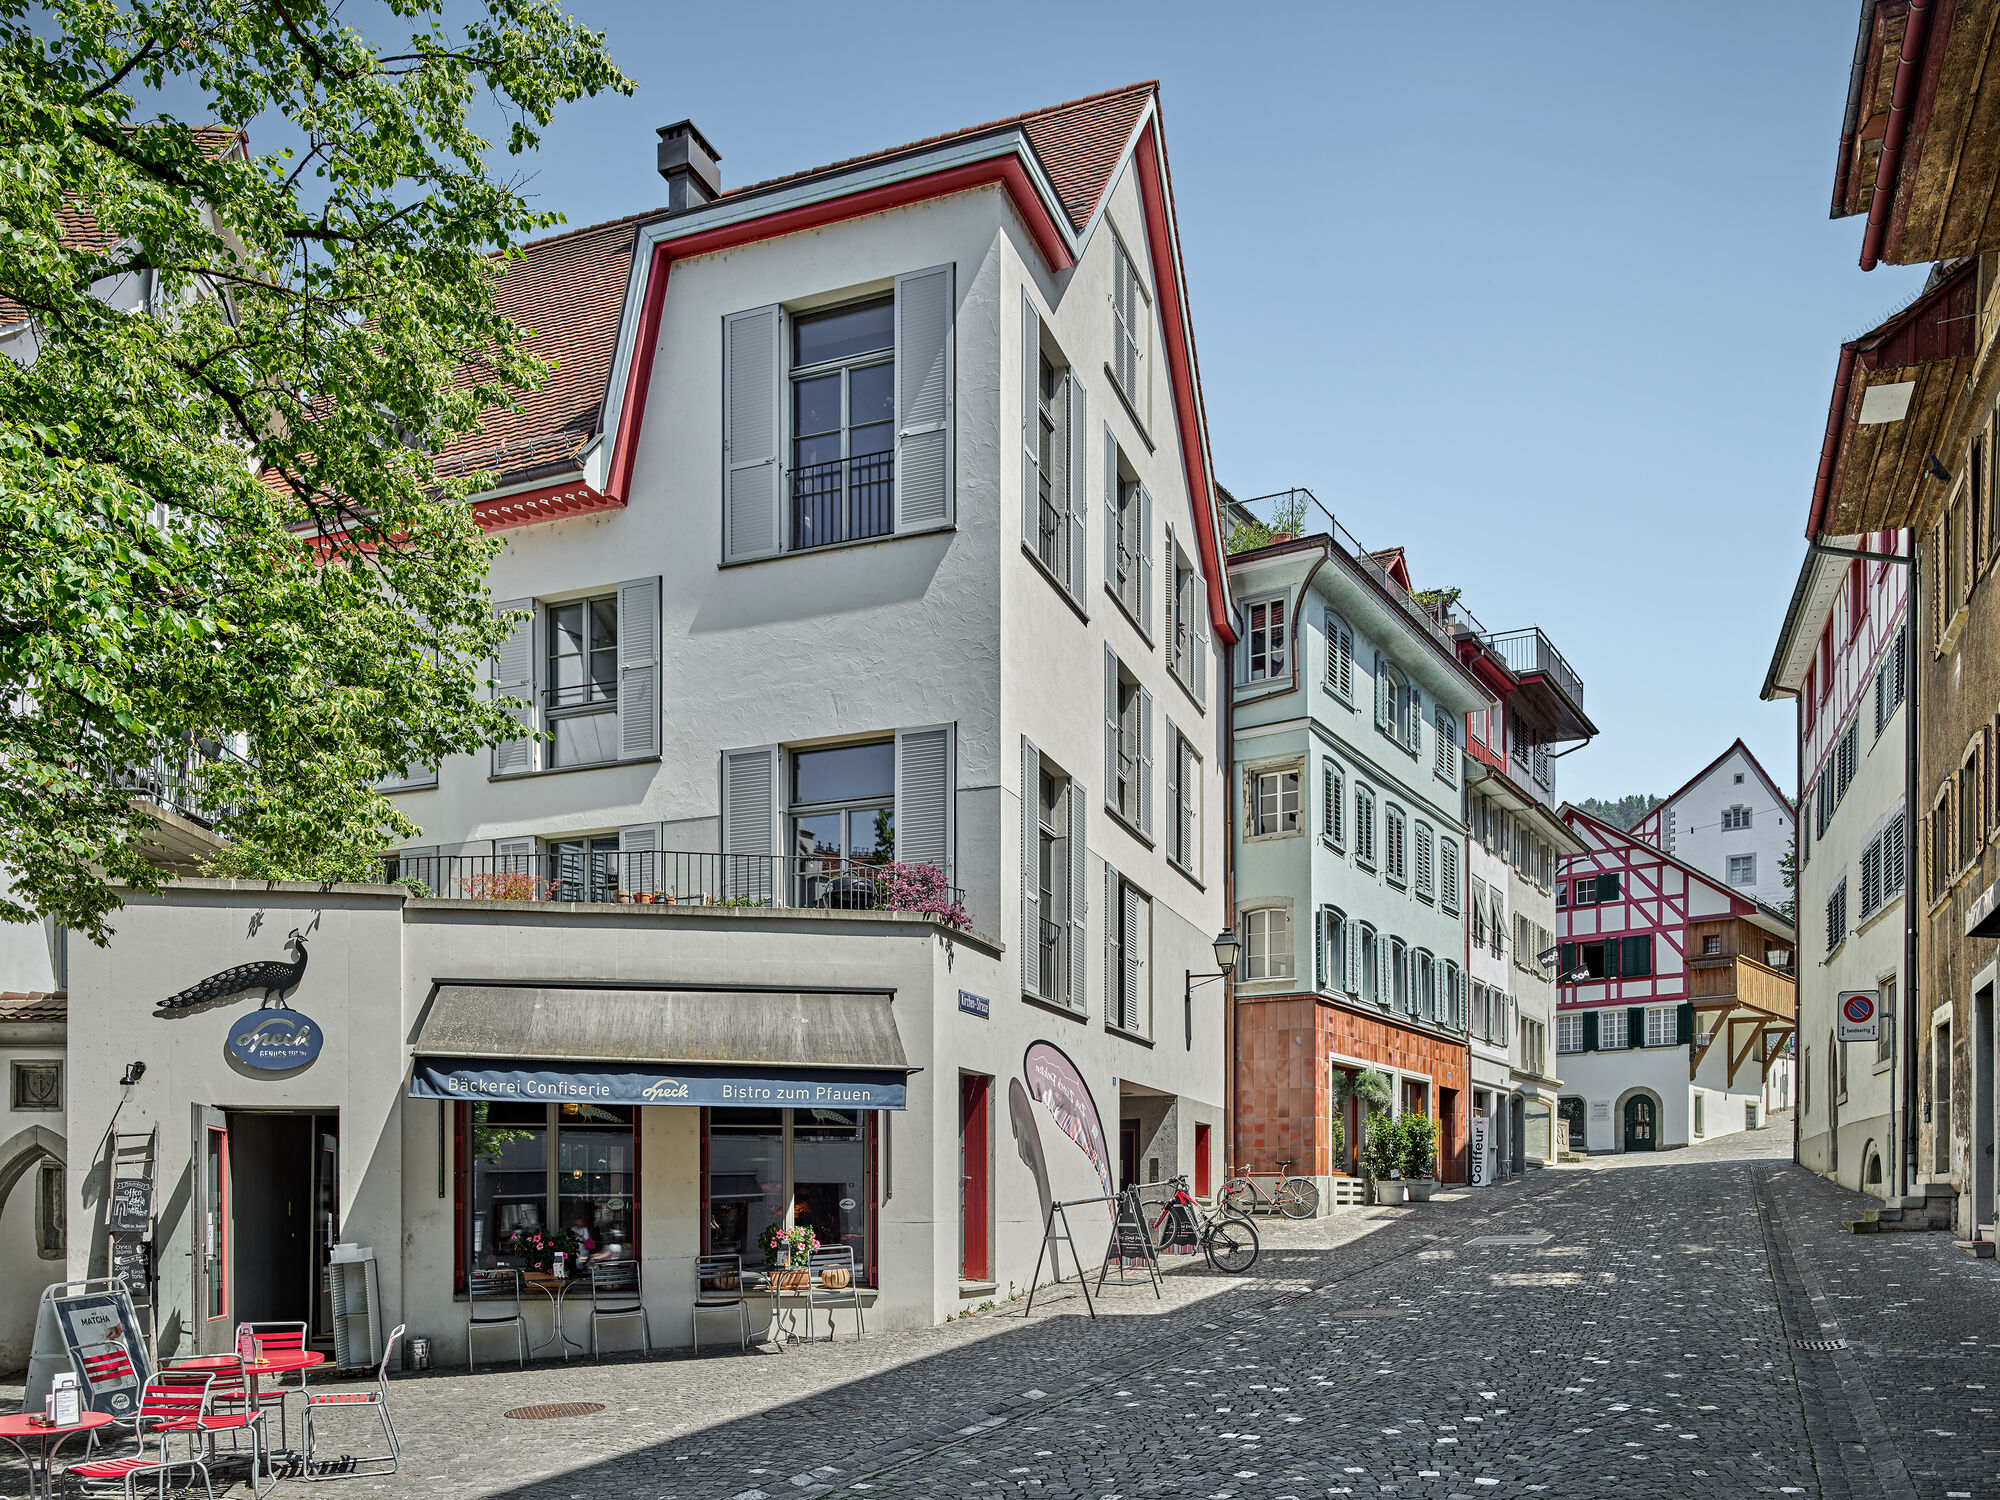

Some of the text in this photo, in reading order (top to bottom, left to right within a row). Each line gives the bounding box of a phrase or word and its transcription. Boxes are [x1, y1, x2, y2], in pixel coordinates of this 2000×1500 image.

[236, 1018, 311, 1053] Speck
[448, 1077, 611, 1096] Bäckerei Confiserie
[642, 1079, 689, 1101] Speck
[722, 1085, 872, 1101] Bistro zum Pfauen
[1472, 1128, 1484, 1184] Coiffeur
[81, 1315, 111, 1326] MATCHA
